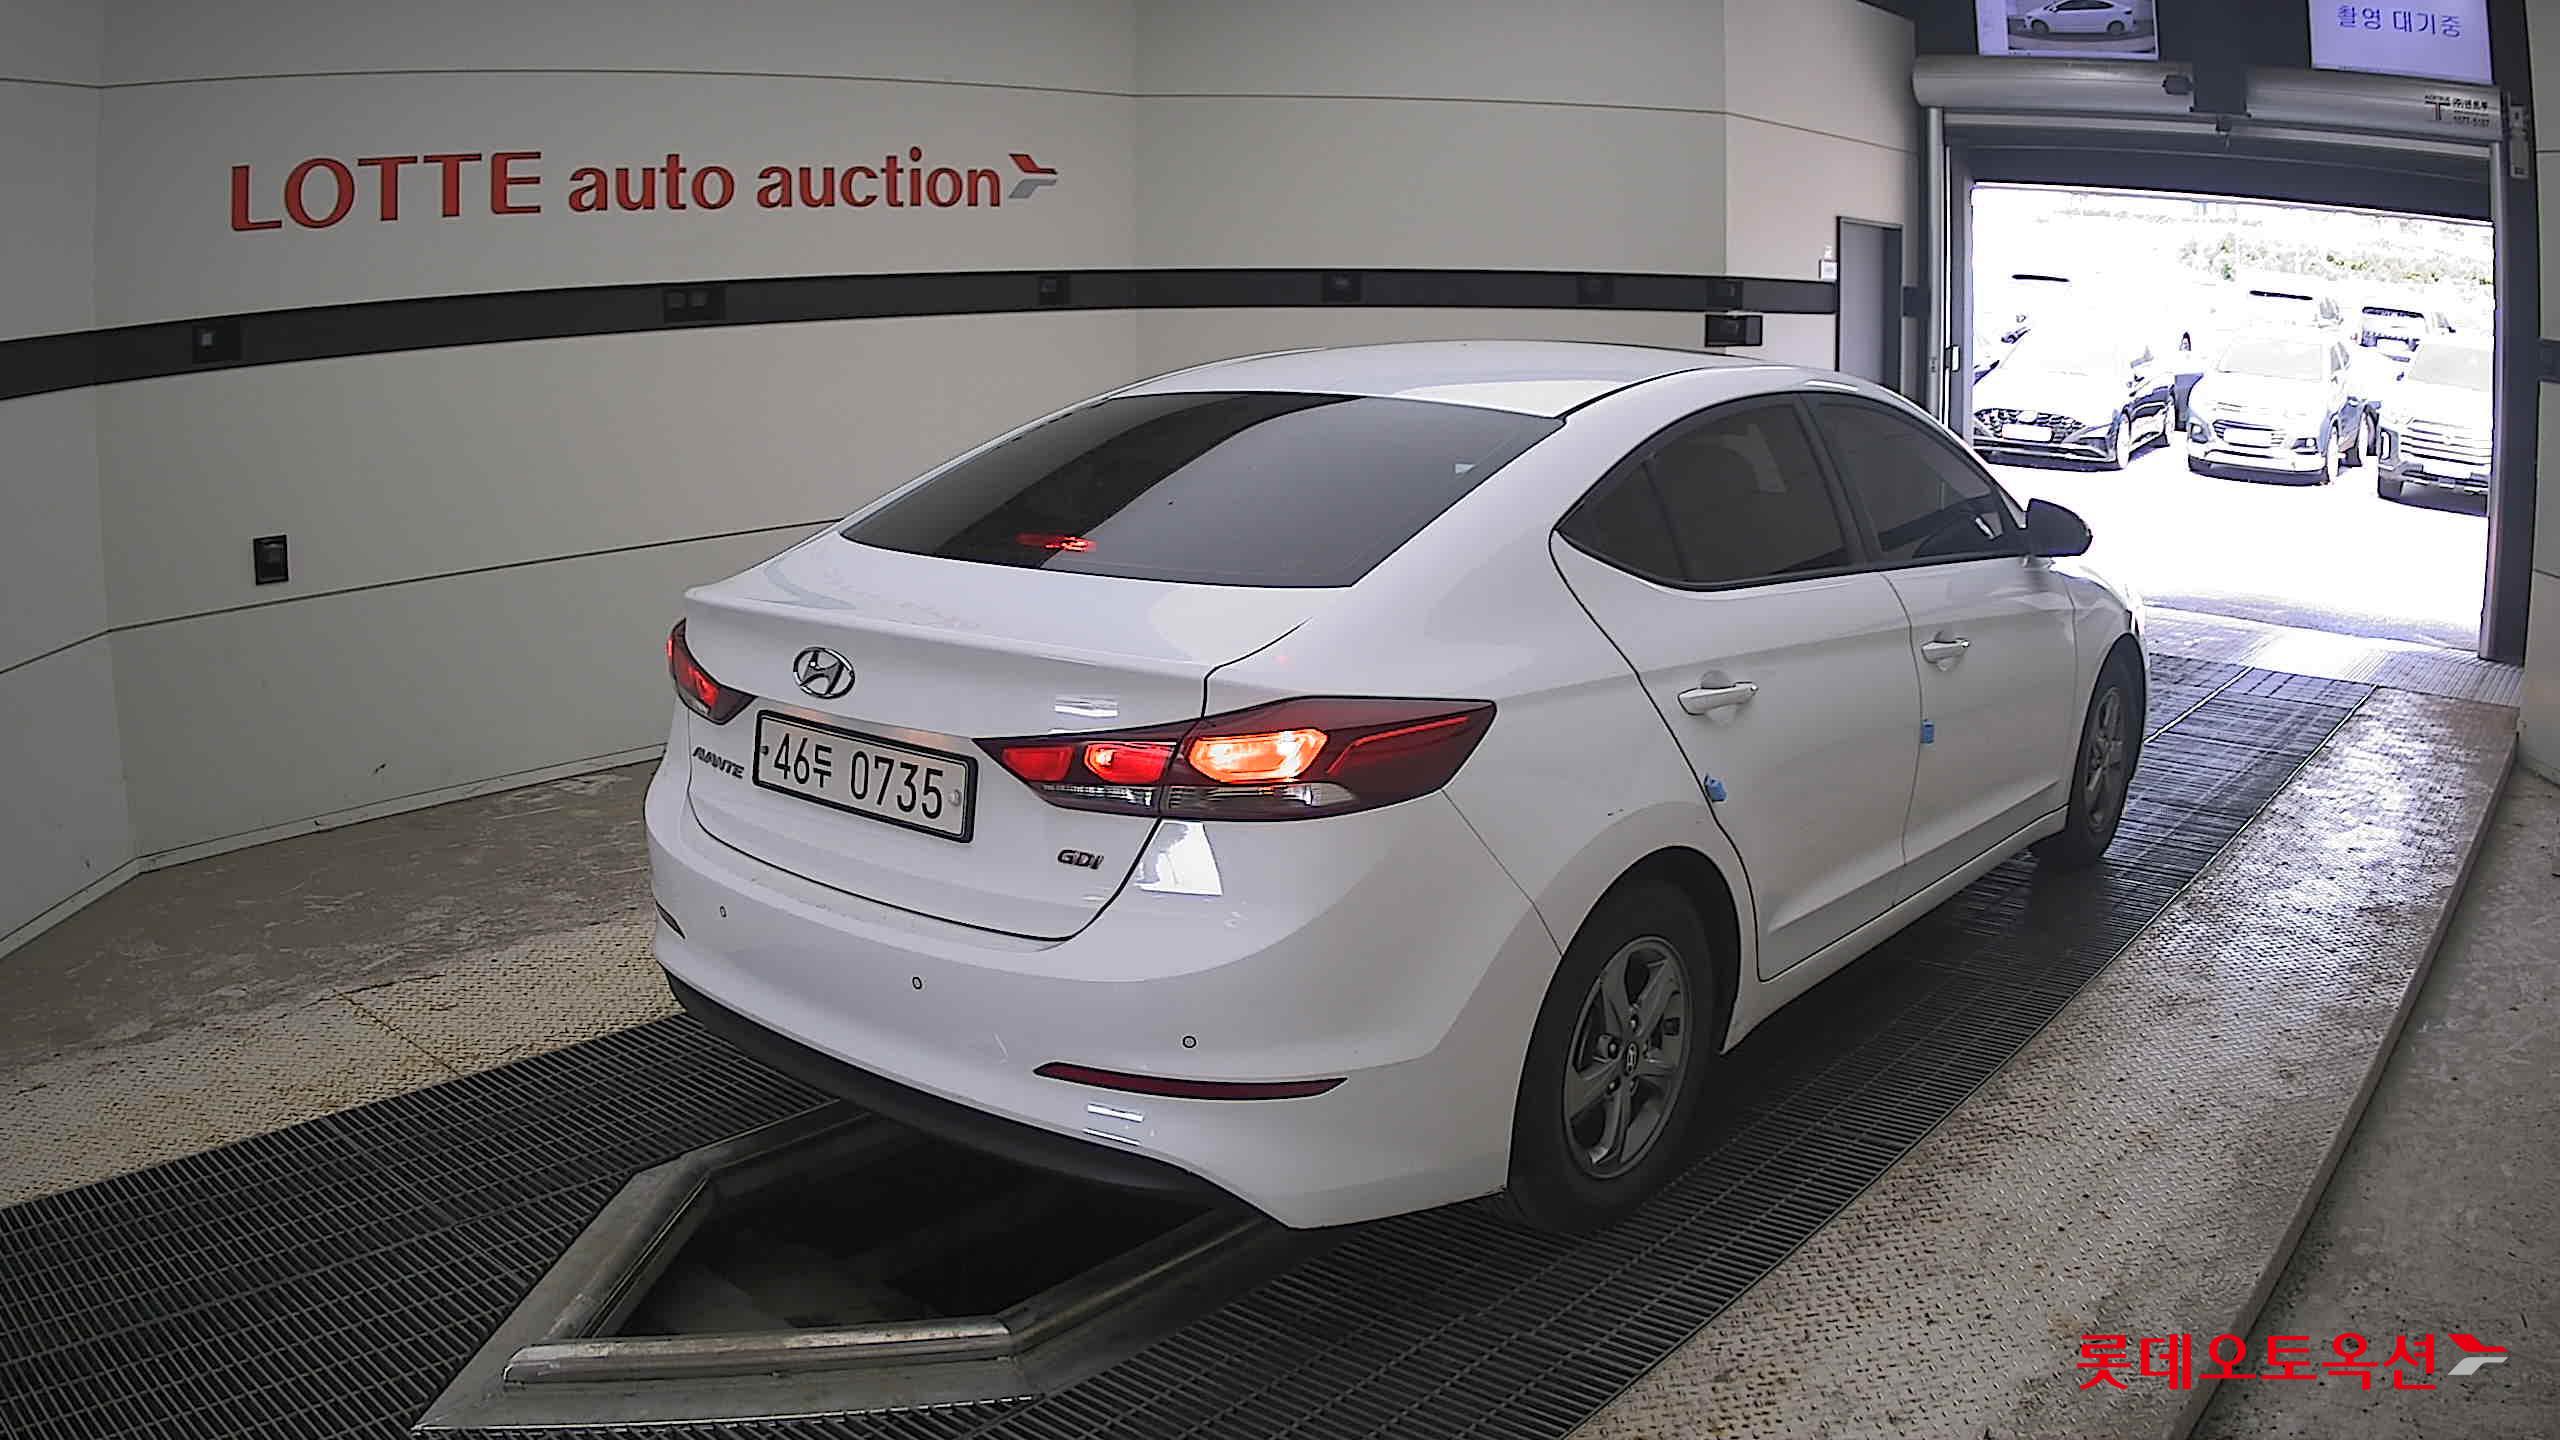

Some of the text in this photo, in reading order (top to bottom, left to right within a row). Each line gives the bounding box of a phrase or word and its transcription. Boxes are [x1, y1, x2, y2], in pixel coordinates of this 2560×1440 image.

[2338, 5, 2461, 38] 촬영 대기중
[232, 147, 1000, 231] LOTTE auto auction
[692, 746, 744, 779] AVANTE
[774, 733, 943, 819] 46두 0735
